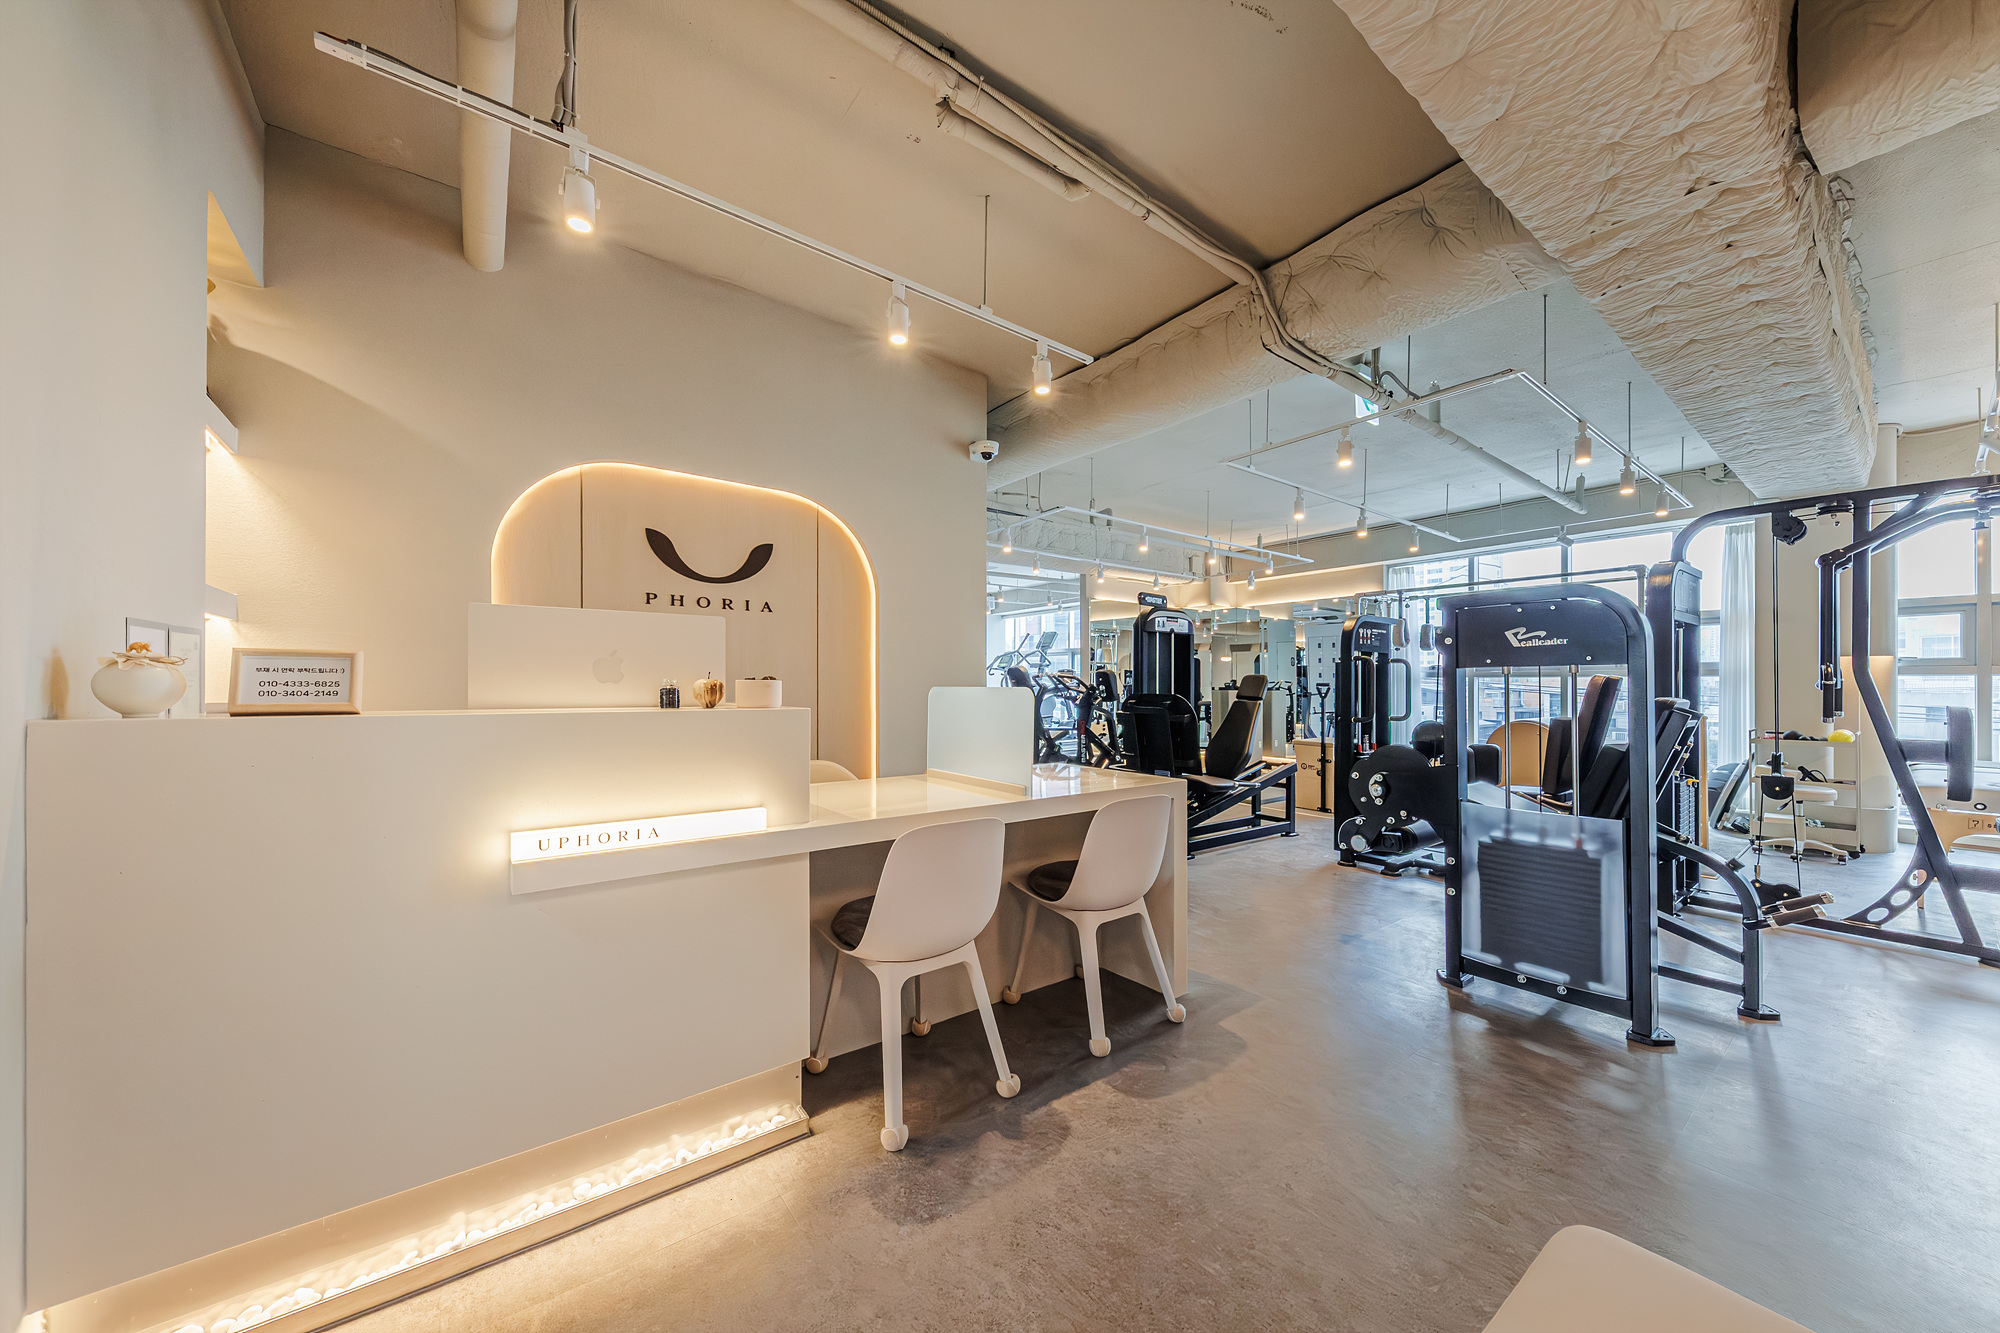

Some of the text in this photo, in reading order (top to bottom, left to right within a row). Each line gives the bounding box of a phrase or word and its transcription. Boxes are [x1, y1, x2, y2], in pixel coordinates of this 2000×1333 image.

[645, 592, 773, 613] PHORIA
[258, 680, 341, 688] 010-4333-6825
[538, 826, 660, 851] UPHORIA
